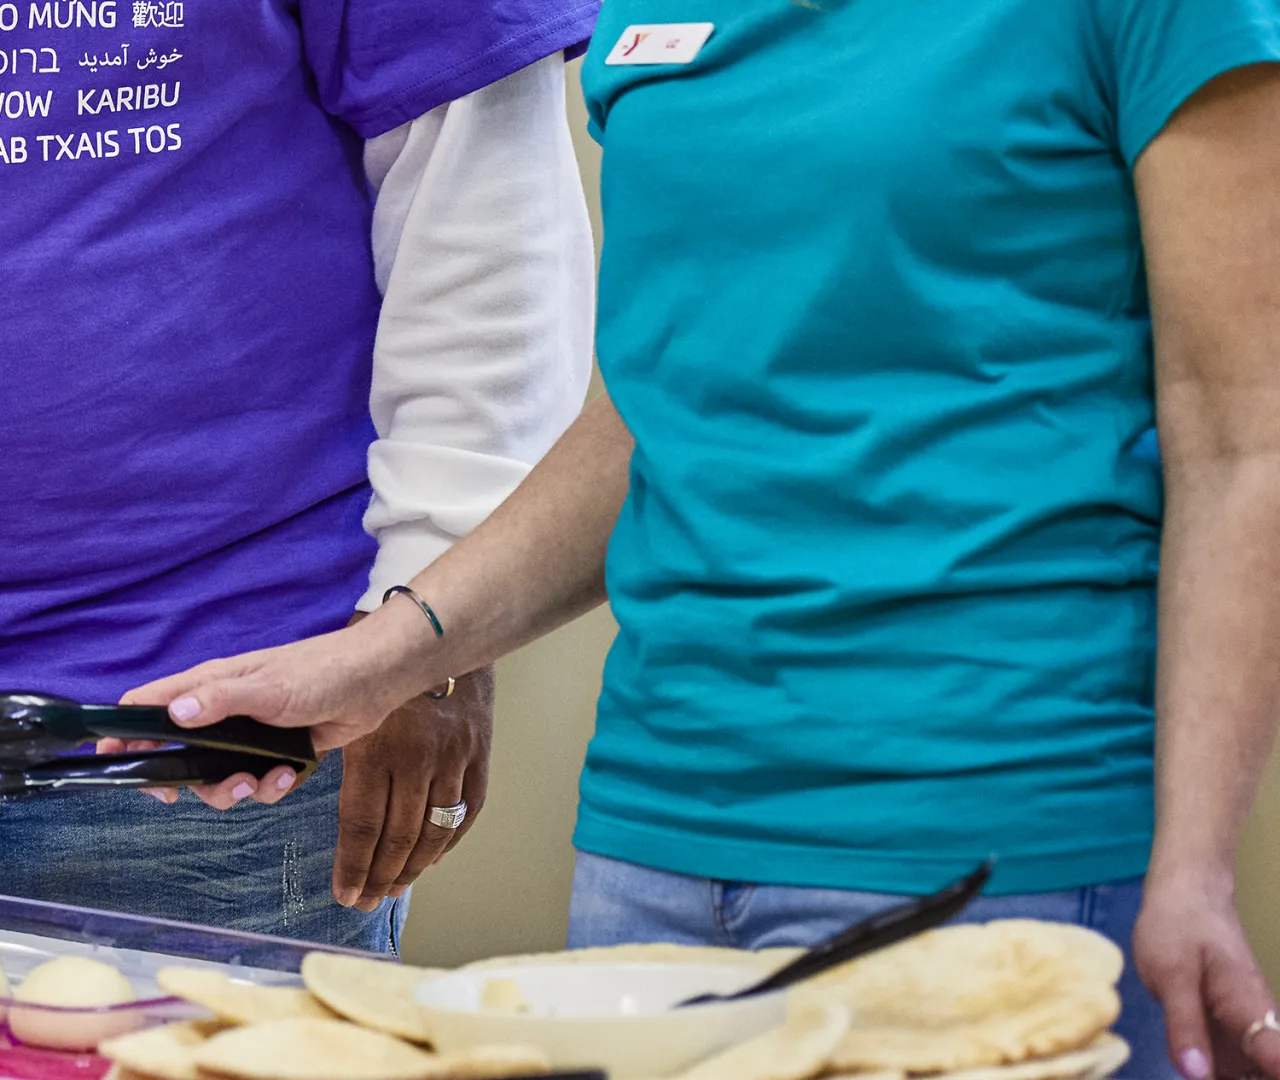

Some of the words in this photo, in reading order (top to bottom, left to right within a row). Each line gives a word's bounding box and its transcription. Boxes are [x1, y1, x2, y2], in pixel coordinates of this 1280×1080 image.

[131, 0, 185, 28] 歡迎
[136, 47, 183, 70] خوش
[77, 81, 181, 116] KARIBU
[36, 129, 120, 162] TXAIS
[127, 123, 182, 155] TOS
